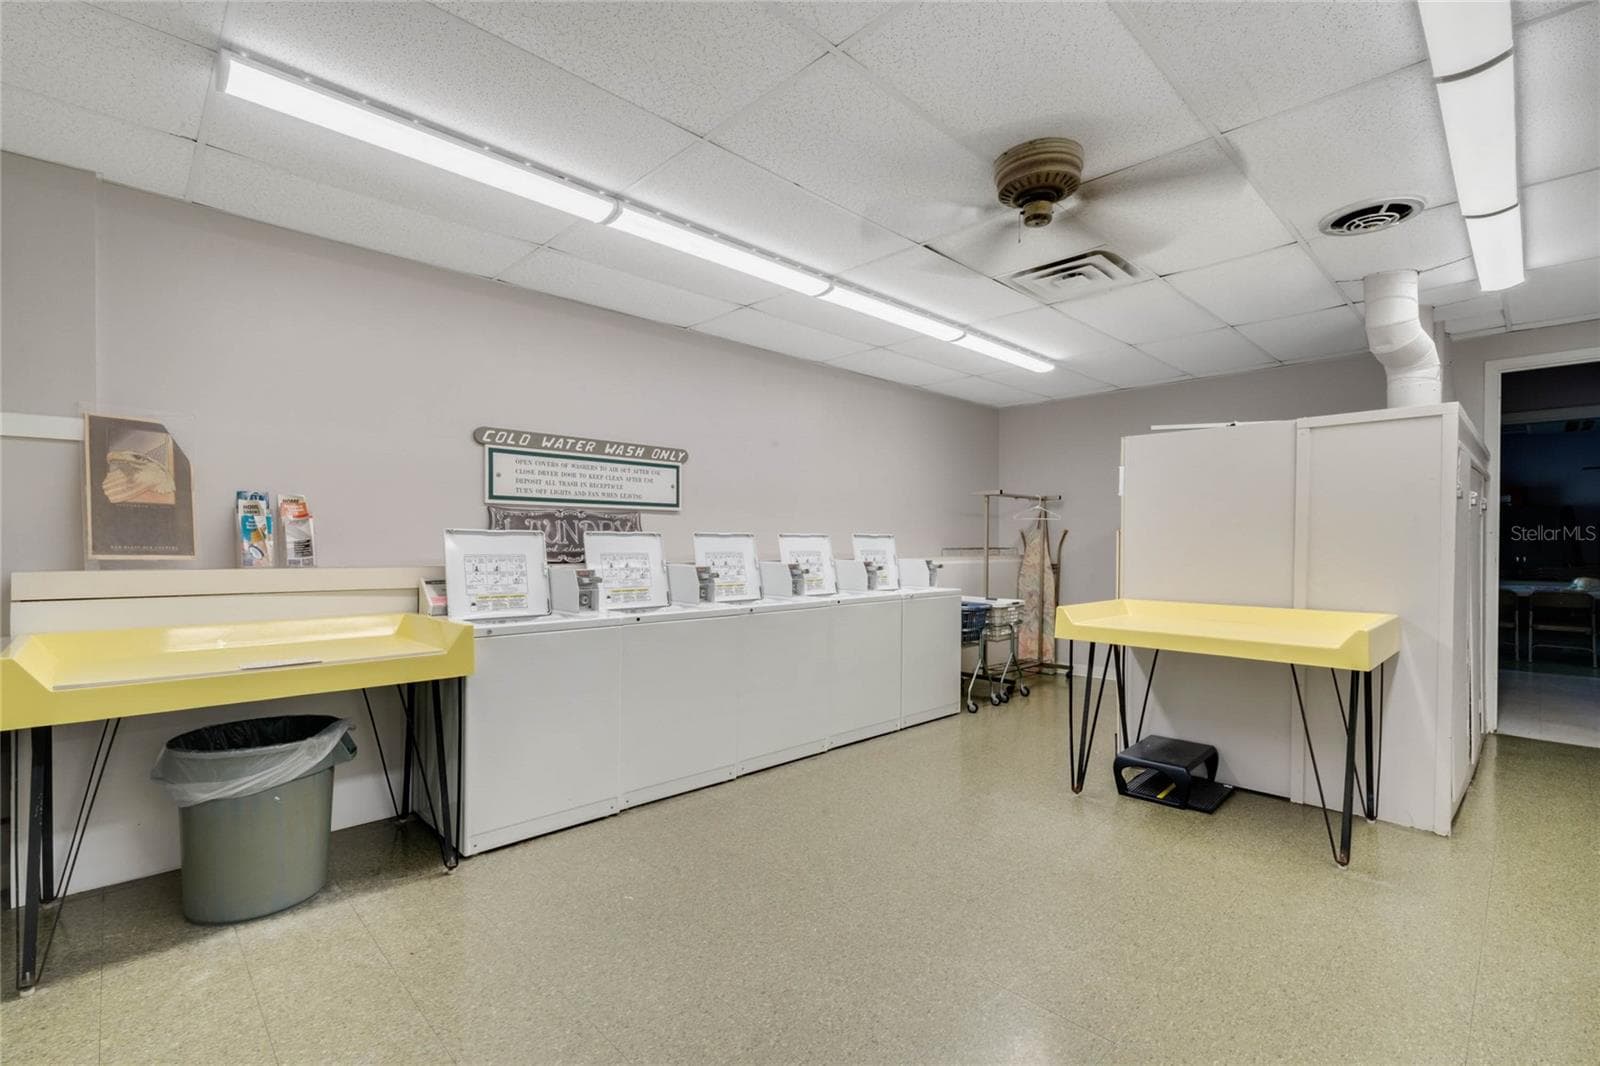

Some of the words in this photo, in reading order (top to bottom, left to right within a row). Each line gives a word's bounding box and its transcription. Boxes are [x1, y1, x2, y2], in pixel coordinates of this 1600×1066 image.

[482, 430, 531, 446] COLD
[541, 436, 597, 453] WATER
[604, 443, 645, 457] WASH
[651, 448, 686, 462] ONLY
[570, 463, 598, 471] WASHERS
